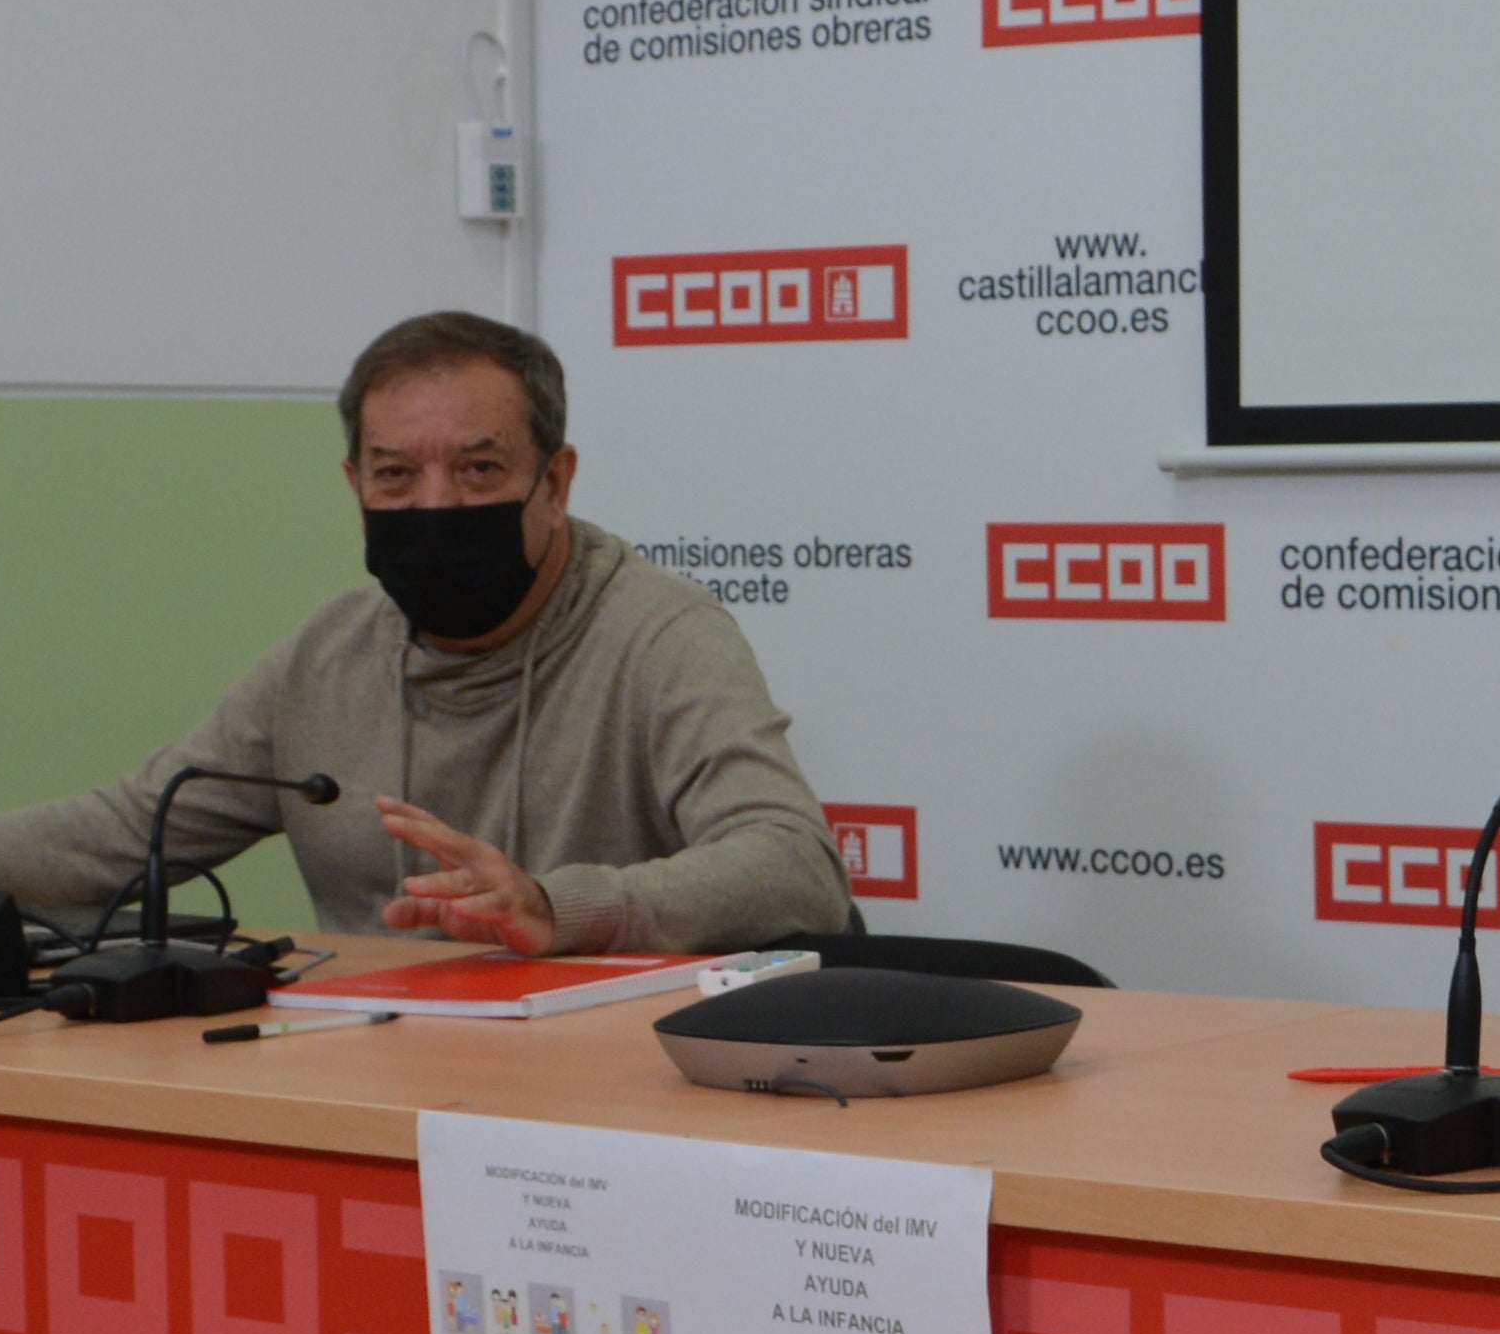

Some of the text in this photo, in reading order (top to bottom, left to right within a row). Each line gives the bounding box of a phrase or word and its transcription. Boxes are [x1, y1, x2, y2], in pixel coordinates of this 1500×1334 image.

[583, 14, 932, 66] de comisiones obreras
[1054, 232, 1147, 260] www.
[627, 269, 809, 329] CCOO
[958, 263, 1198, 302] castillalamanc
[1035, 306, 1170, 337] ccoo.es
[793, 535, 913, 569] obreras
[1003, 543, 1209, 601] CCOO
[1280, 574, 1326, 610] de
[998, 845, 1226, 880] www.ccoo.es
[735, 1198, 938, 1239] MODIFICACIÓN del IMV
[795, 1240, 874, 1265] Y NUEVA
[804, 1275, 868, 1299] AYUDA
[772, 1305, 785, 1322] A
[789, 1307, 814, 1326] LA
